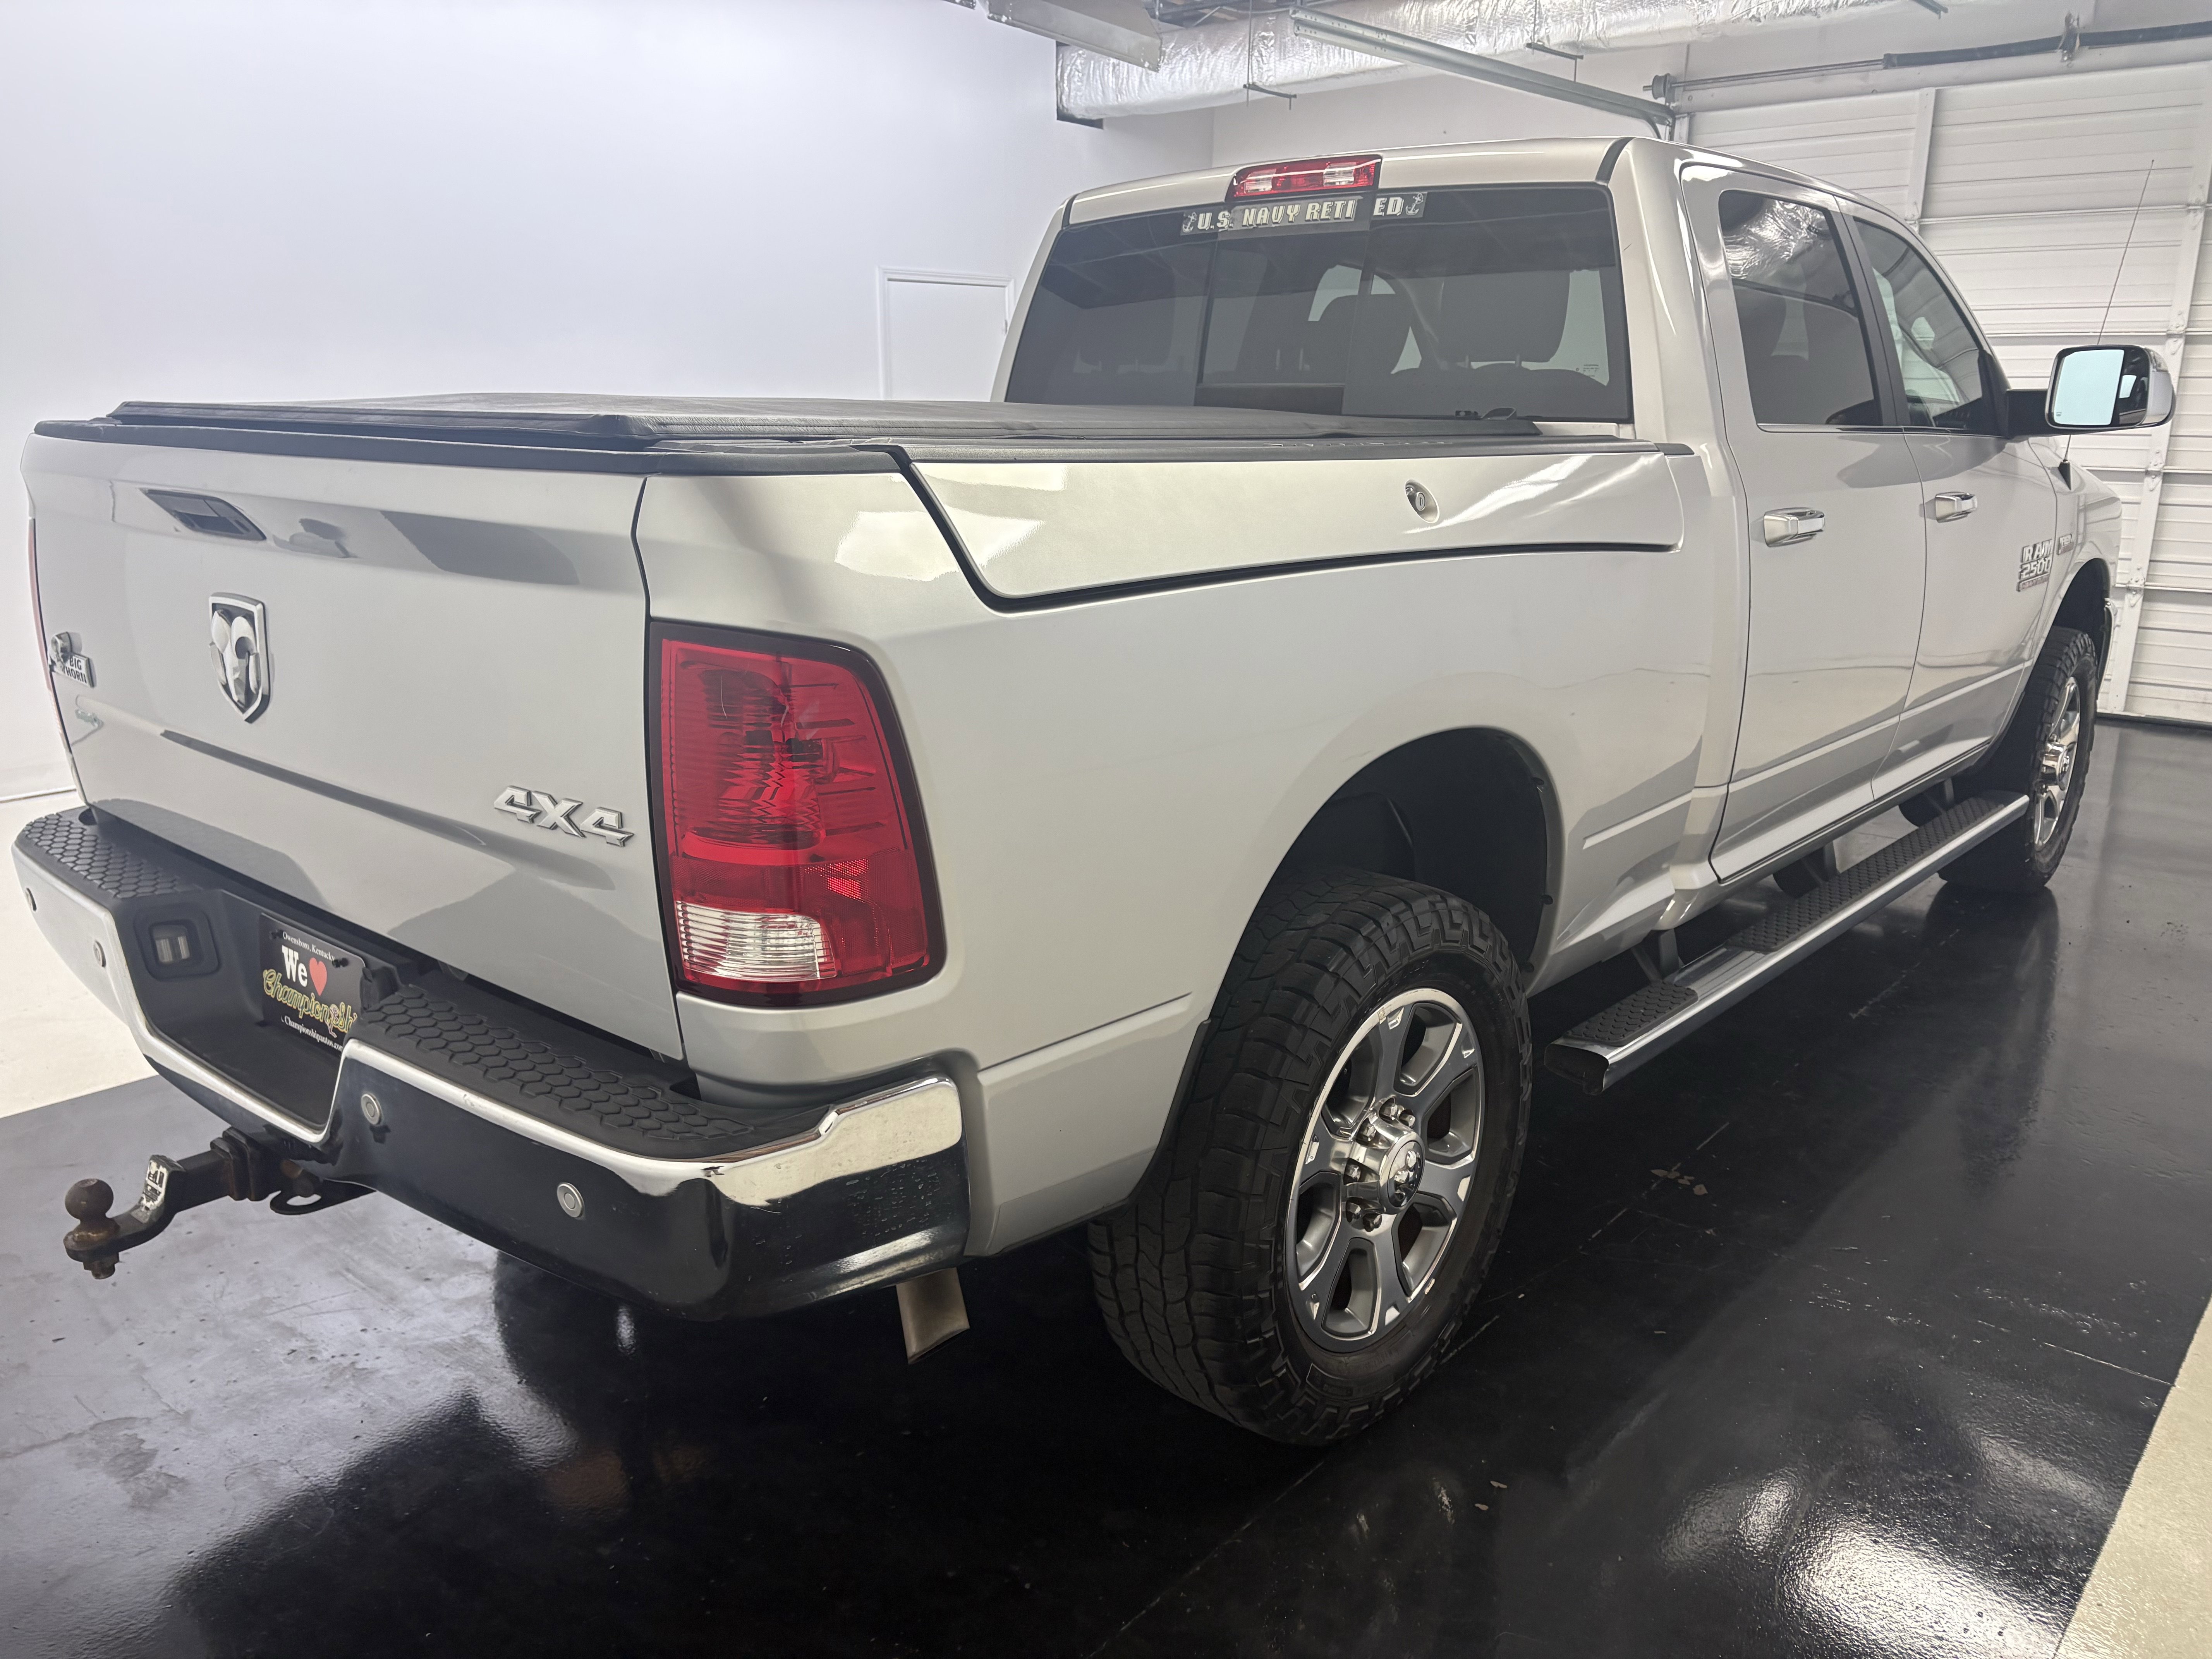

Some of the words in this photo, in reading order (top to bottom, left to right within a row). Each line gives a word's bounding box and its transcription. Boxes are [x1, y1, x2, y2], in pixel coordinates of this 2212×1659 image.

[1197, 211, 1233, 231] U.S.
[1242, 204, 1301, 226] NAVY
[2021, 539, 2052, 562] RAM
[2019, 556, 2052, 579] 2500
[65, 666, 87, 684] HORN
[70, 657, 81, 670] BIG
[283, 931, 311, 951] Owensboro,
[282, 945, 307, 987] We
